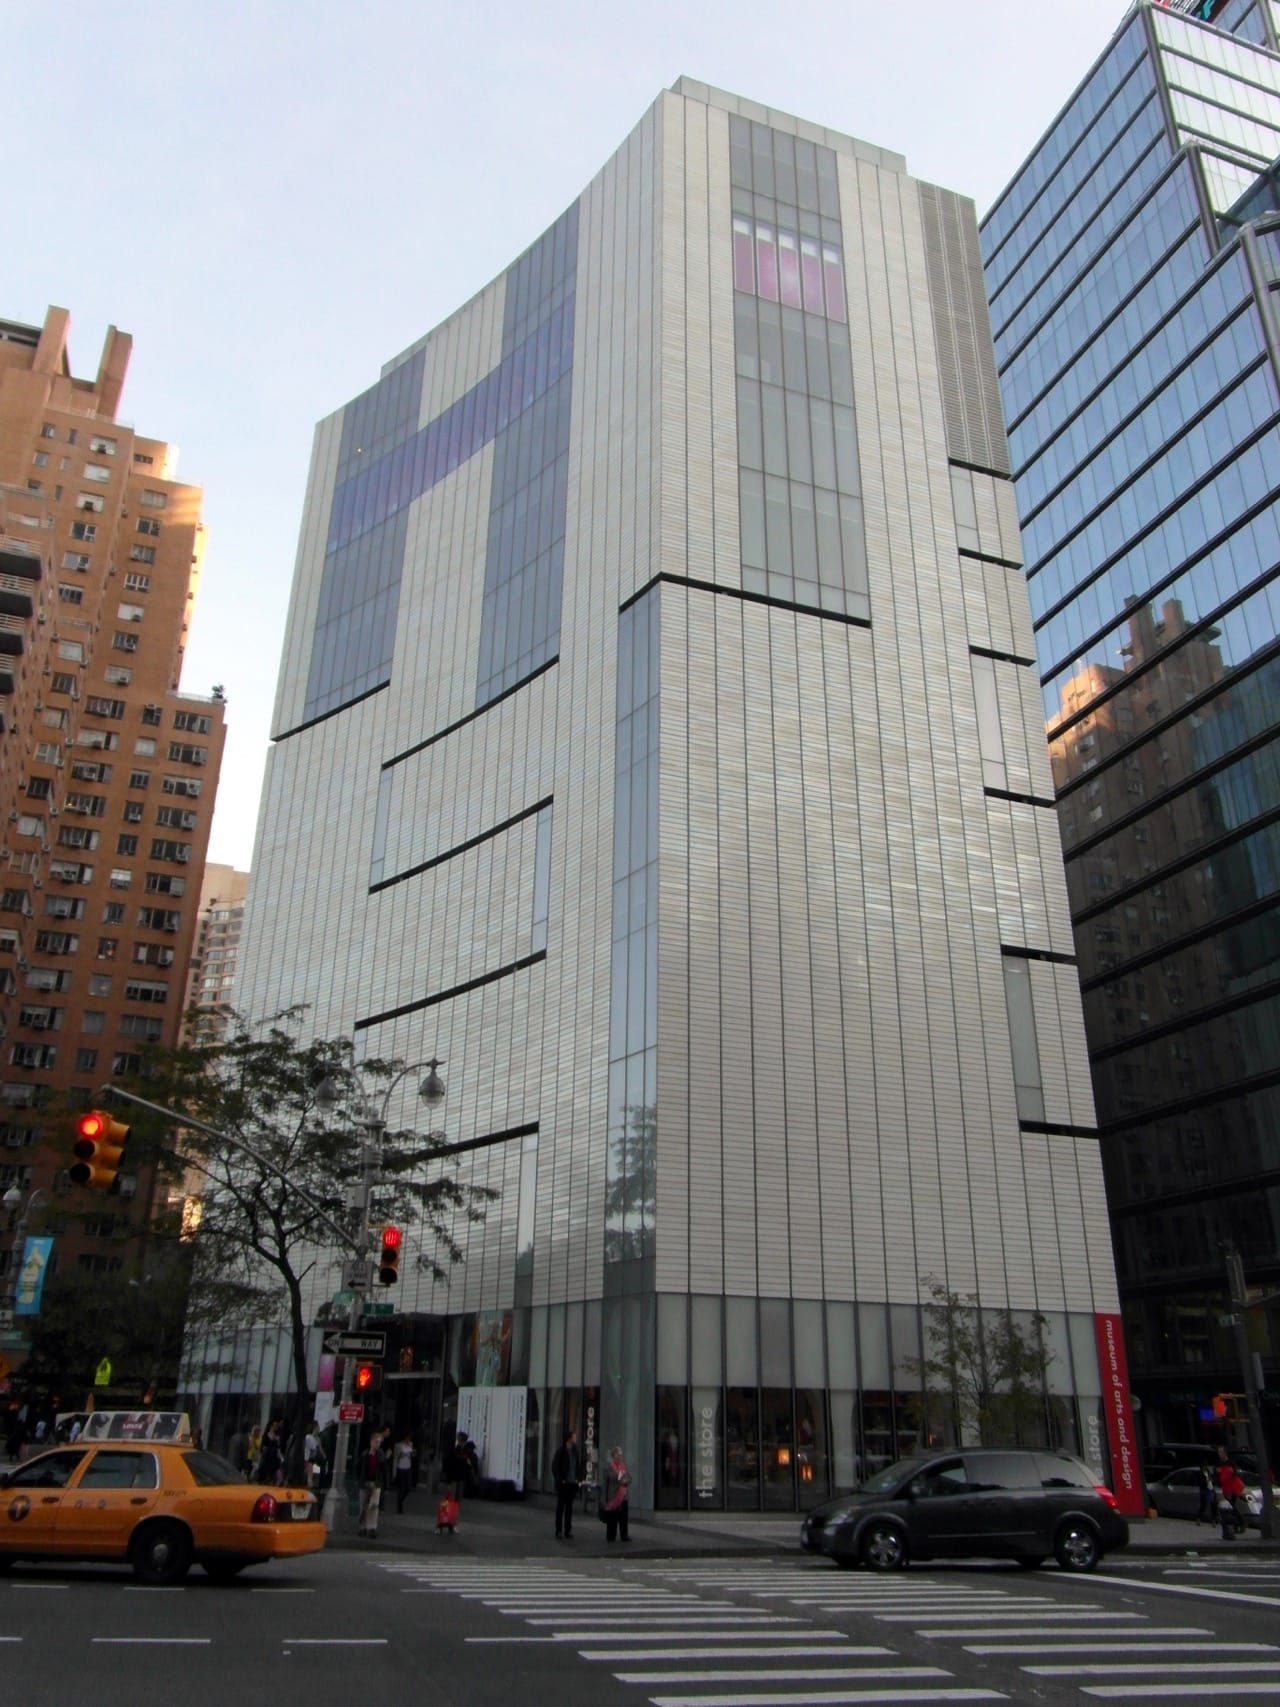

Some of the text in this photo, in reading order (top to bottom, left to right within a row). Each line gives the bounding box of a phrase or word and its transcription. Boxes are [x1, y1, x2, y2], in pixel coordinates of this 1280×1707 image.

[361, 1340, 378, 1348] WAY
[1088, 1415, 1102, 1461] store
[1105, 1319, 1133, 1489] museum of arts and design
[696, 1407, 713, 1499] the store
